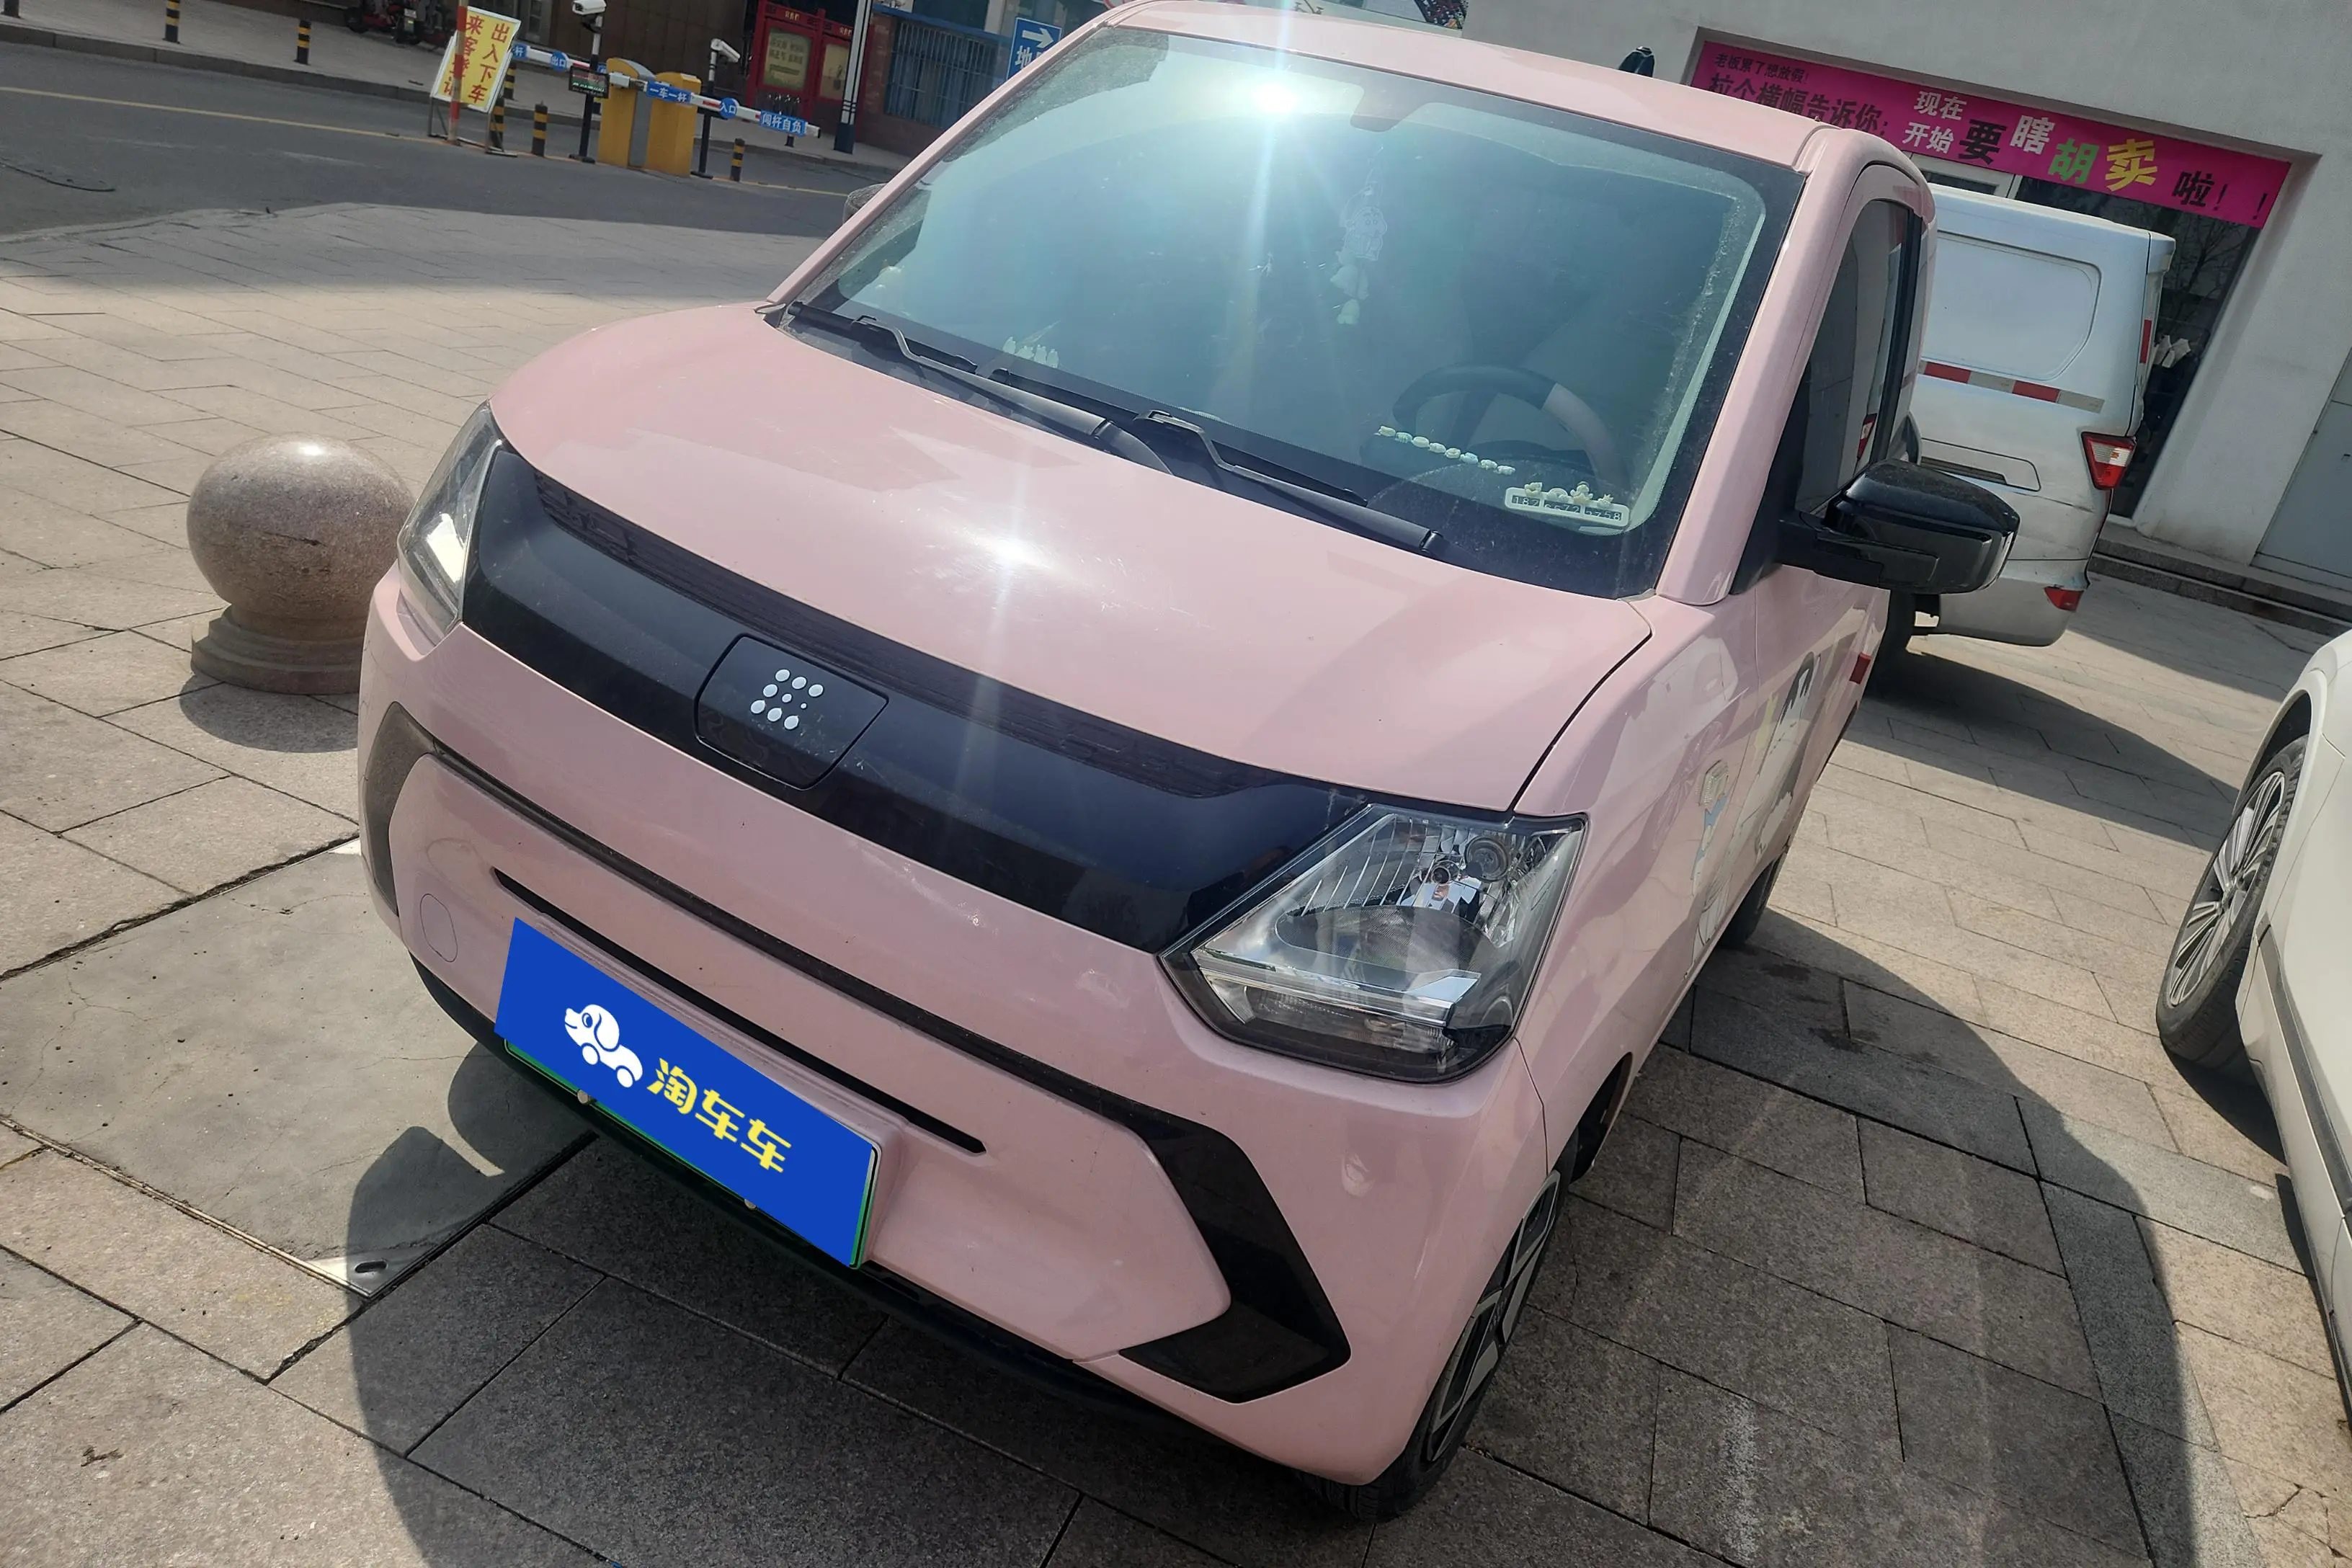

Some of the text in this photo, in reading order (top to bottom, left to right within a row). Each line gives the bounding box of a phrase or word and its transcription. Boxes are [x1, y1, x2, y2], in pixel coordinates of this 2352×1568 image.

[468, 22, 510, 103] 出入下车
[551, 55, 566, 67] 出口
[650, 86, 687, 103] 一车一杆
[1913, 90, 1967, 121] 现在
[721, 102, 737, 115] 入口
[1902, 121, 1955, 151] 开始
